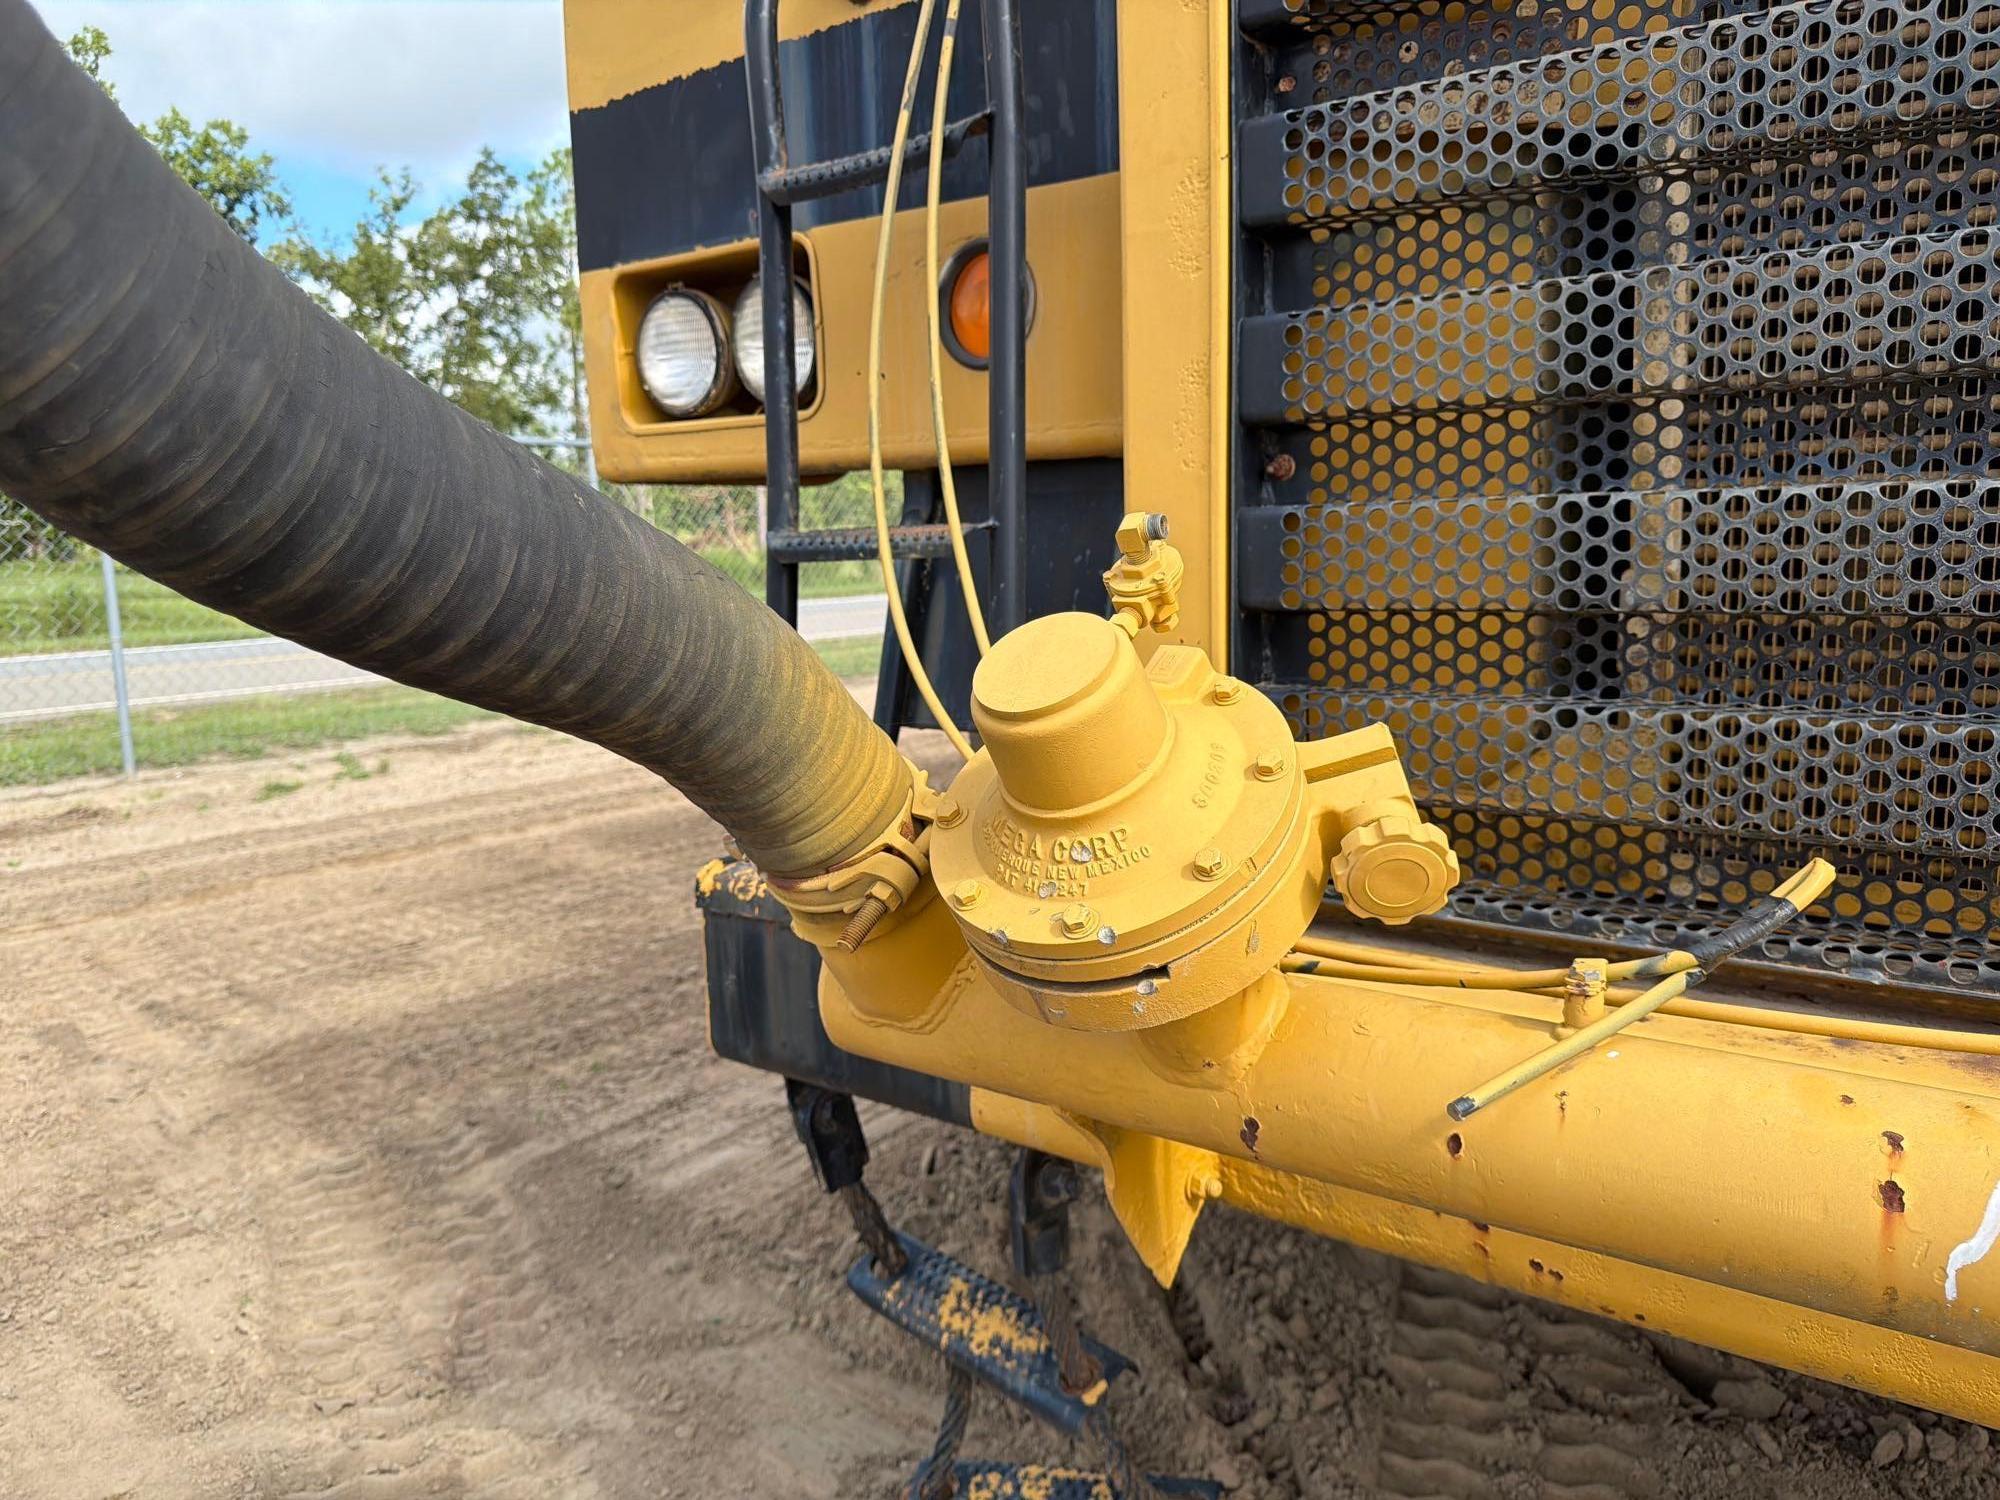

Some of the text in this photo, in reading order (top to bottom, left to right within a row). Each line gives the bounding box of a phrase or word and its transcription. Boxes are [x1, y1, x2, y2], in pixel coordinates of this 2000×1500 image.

[992, 817, 1128, 864] MEGA CORP
[997, 863, 1089, 900] PAT 41247
[1046, 864, 1078, 881] NEW
